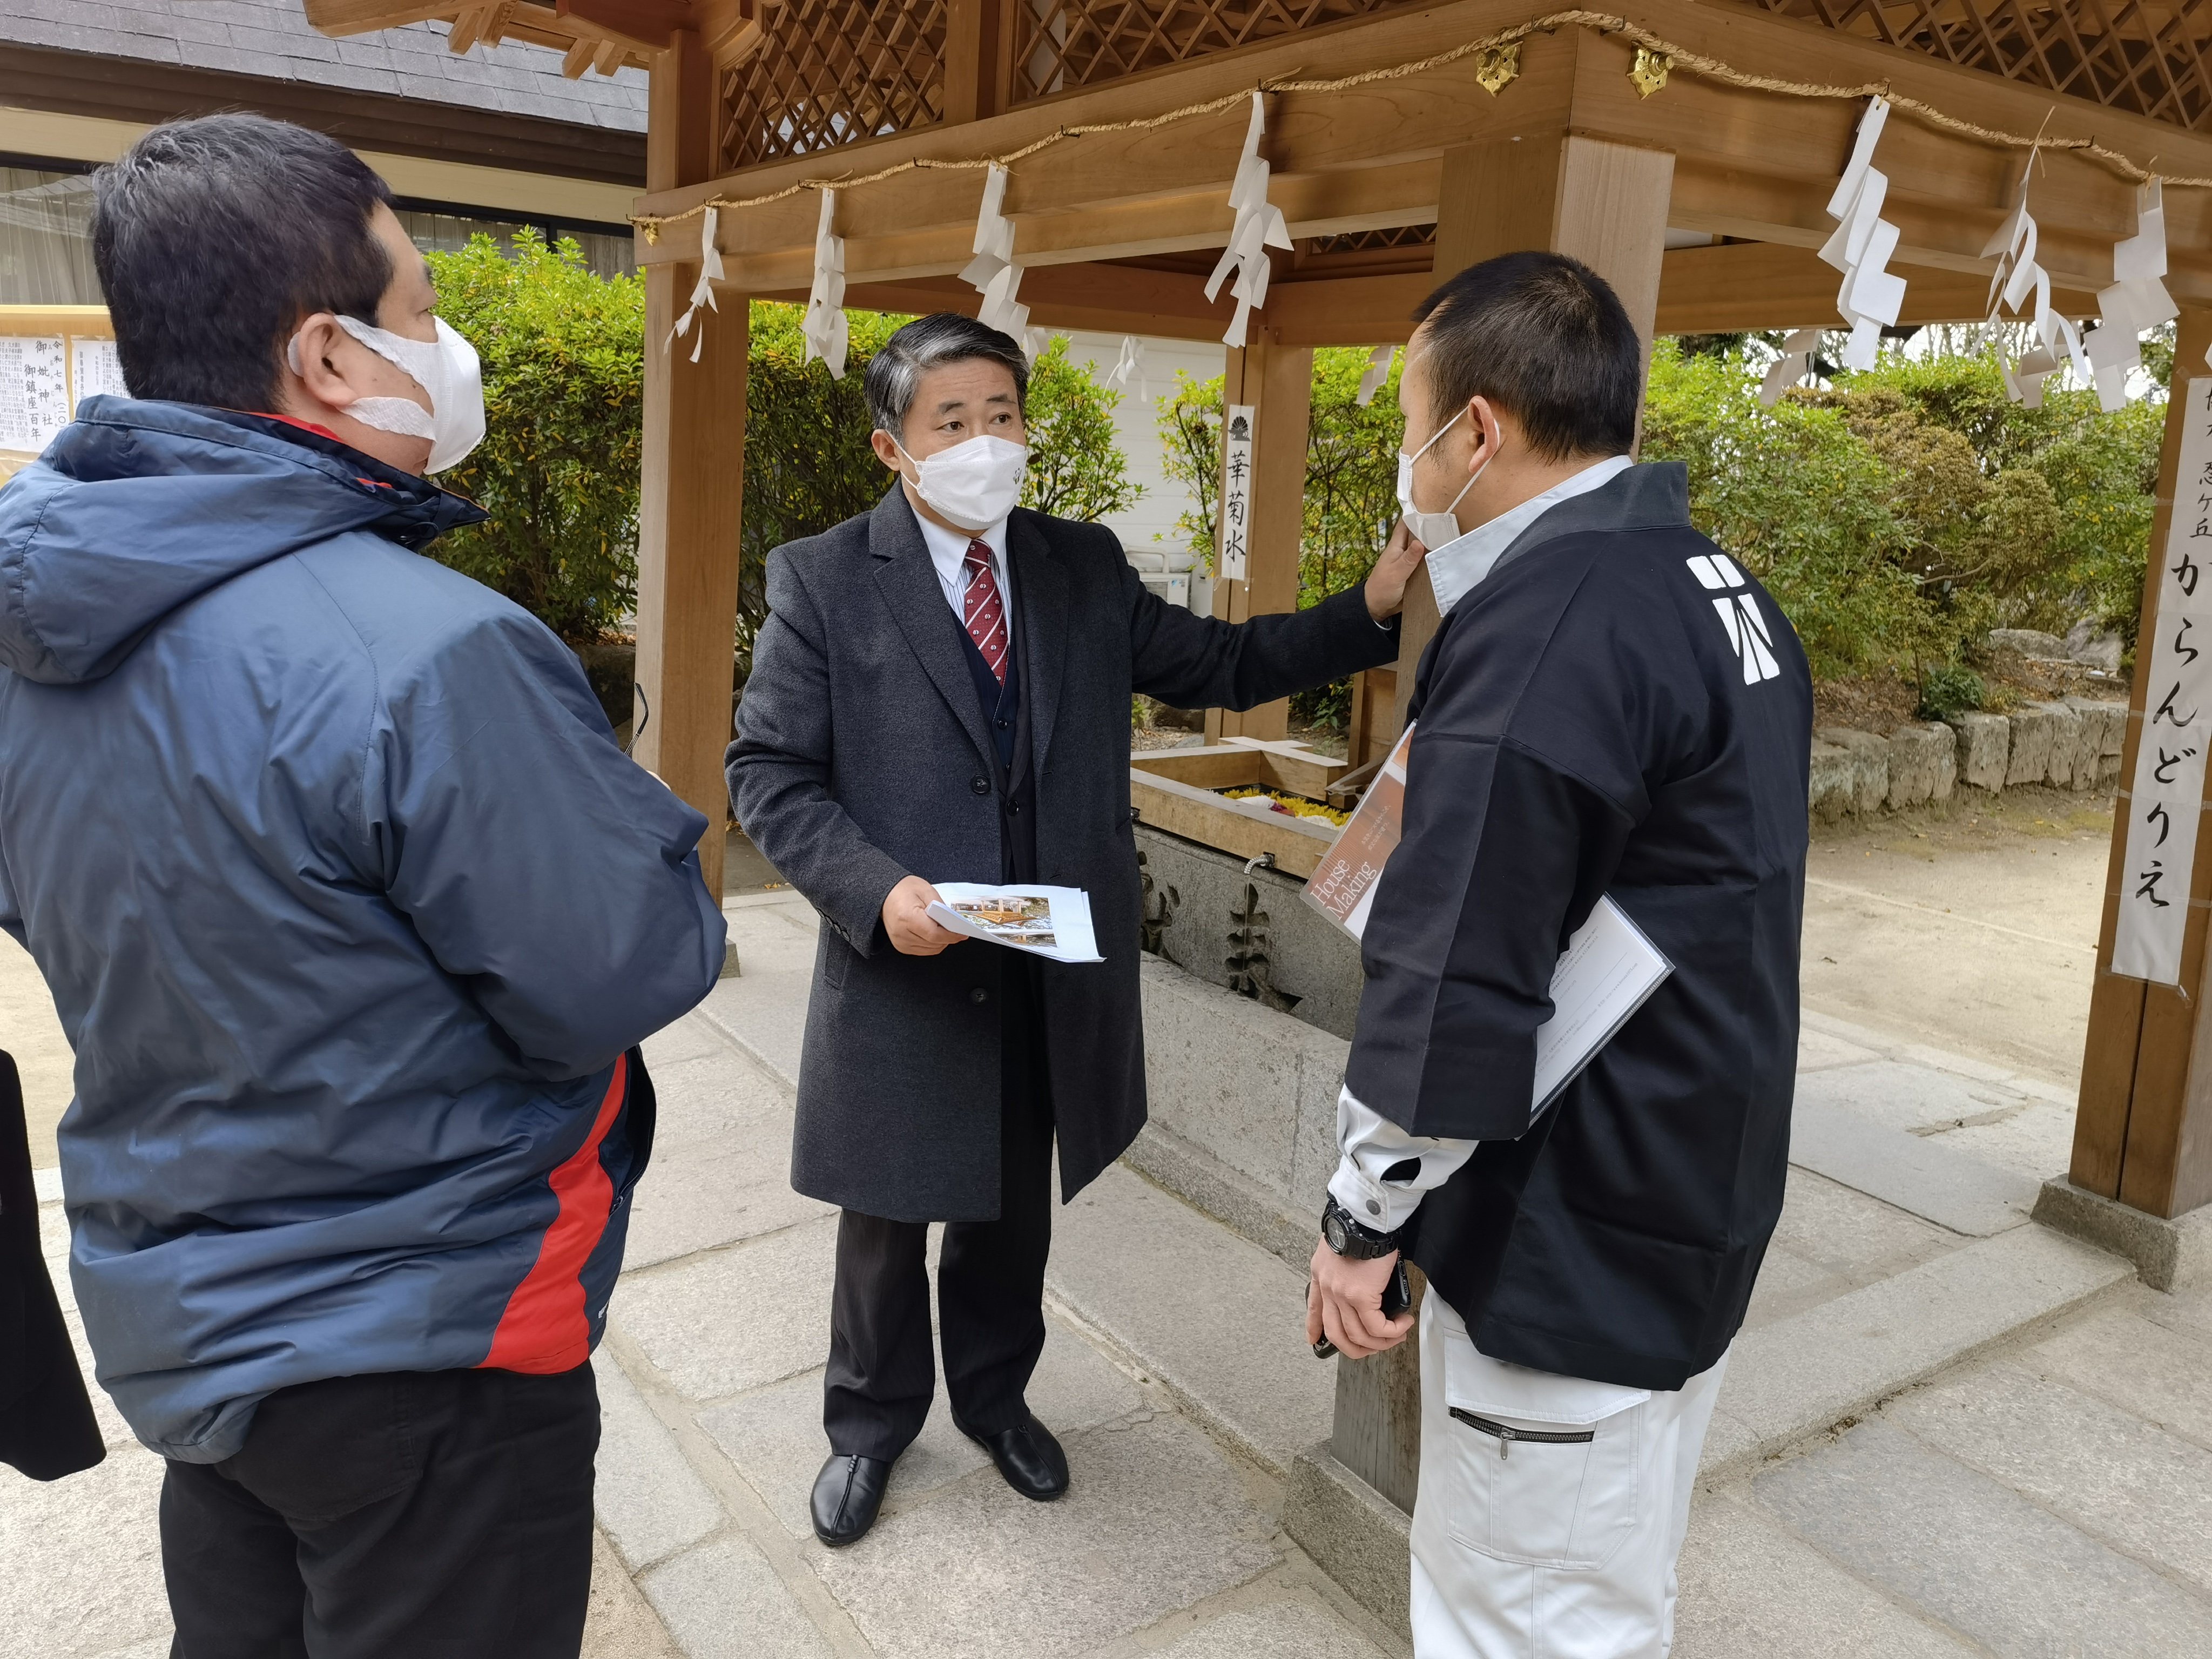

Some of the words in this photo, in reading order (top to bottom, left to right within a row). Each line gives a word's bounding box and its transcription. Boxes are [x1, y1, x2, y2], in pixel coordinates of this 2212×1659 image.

[24, 363, 42, 442] 御鎮座百年
[1224, 450, 1250, 562] 華菊水
[1310, 859, 1350, 907] House
[1326, 861, 1377, 921] Making
